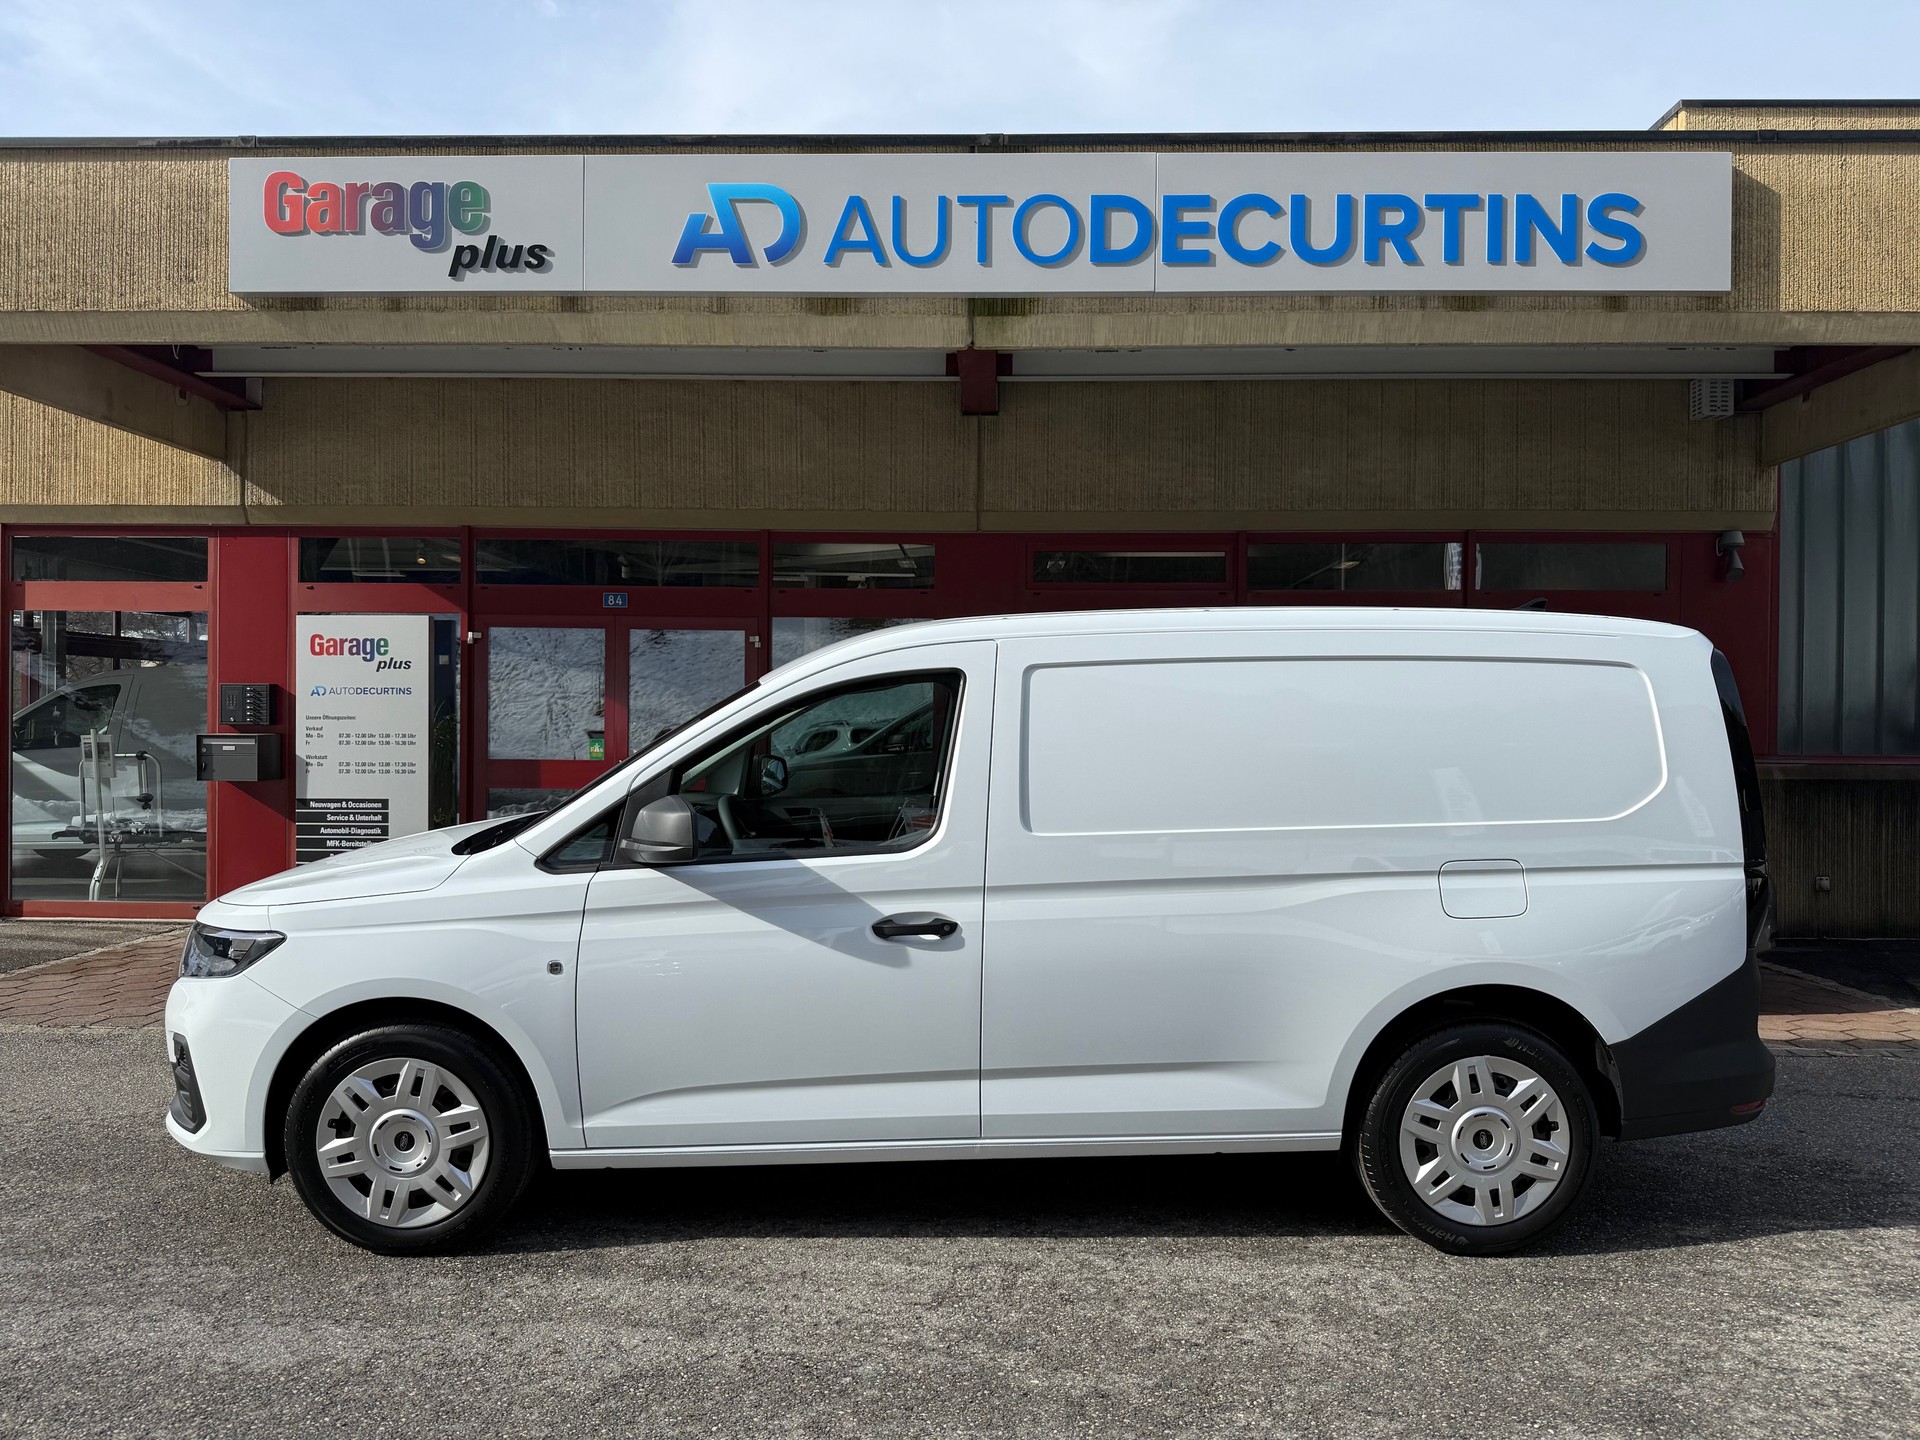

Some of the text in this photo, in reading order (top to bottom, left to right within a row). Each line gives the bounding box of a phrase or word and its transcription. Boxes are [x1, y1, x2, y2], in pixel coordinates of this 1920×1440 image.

[263, 171, 487, 249] Garage
[671, 183, 1645, 267] AD AUTODECURTINS
[448, 236, 548, 278] plus
[608, 595, 622, 605] 84
[310, 633, 389, 662] Garage
[376, 657, 412, 672] plus
[329, 687, 412, 695] AUTODECURTINS
[310, 801, 341, 809] Neuwagen
[320, 827, 381, 835] Automobil-Diagnostik
